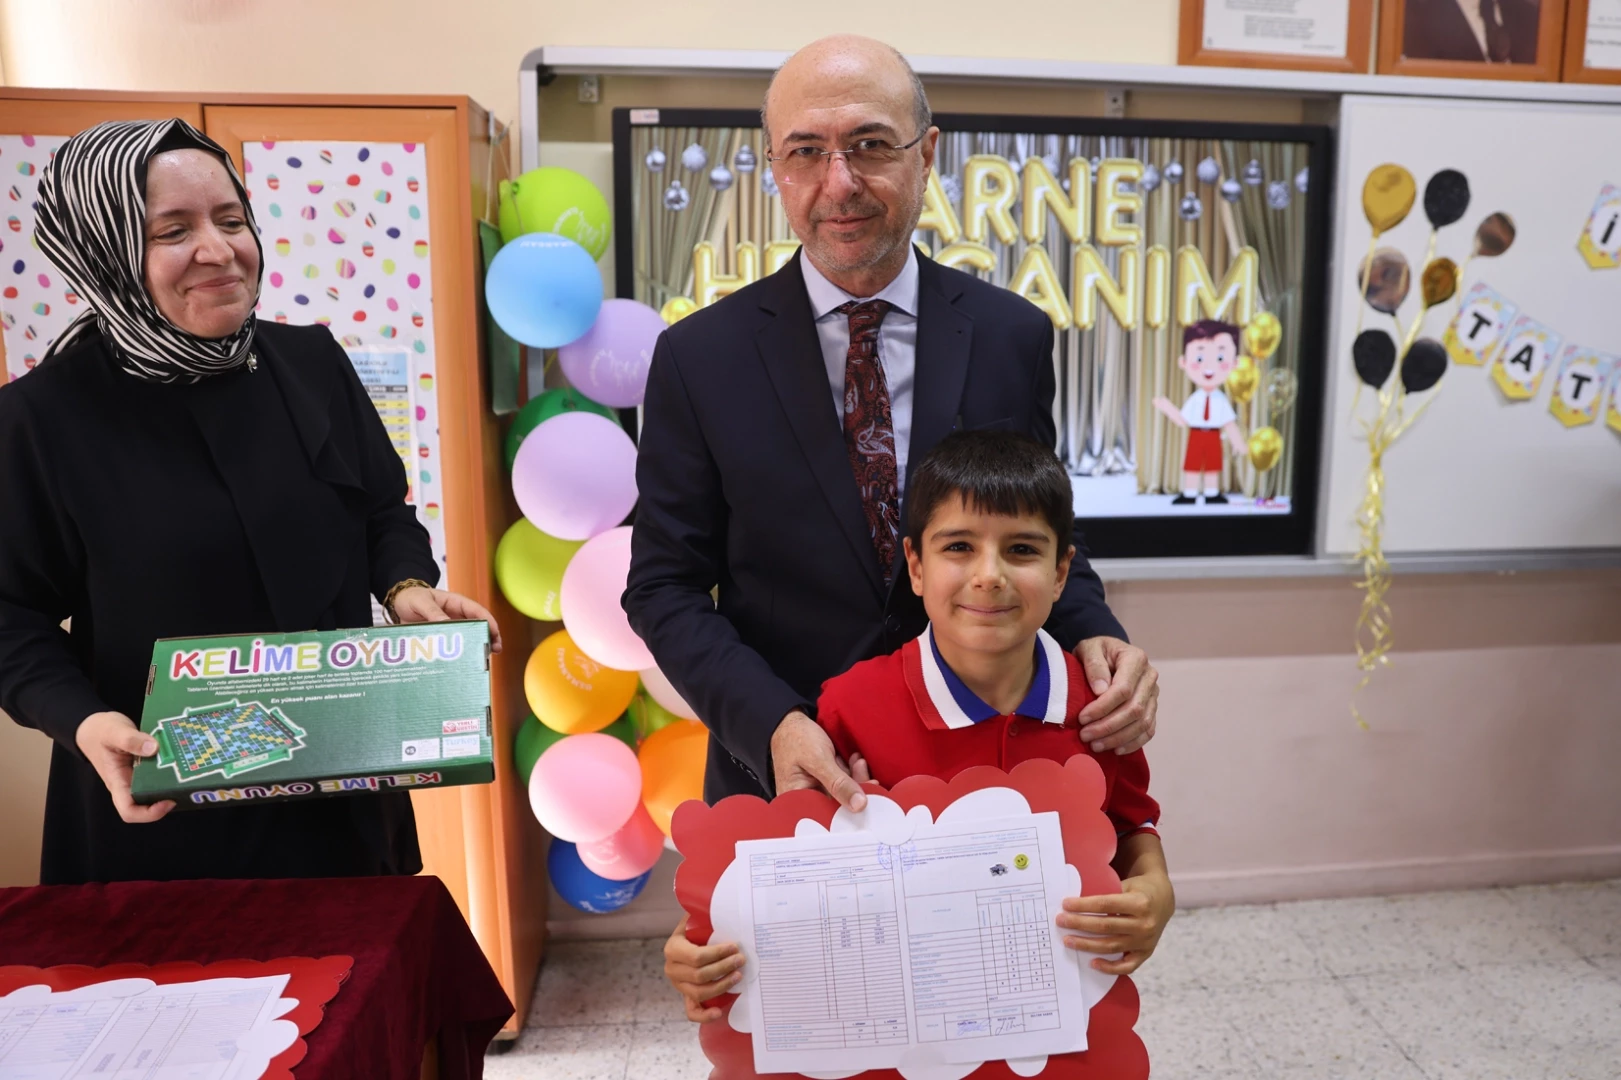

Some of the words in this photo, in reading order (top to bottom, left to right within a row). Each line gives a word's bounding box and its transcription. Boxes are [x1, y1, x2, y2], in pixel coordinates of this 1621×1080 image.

[915, 153, 1143, 246] ARNE
[171, 639, 320, 679] KELİME
[329, 634, 462, 668] OYUNU
[280, 696, 304, 704] yüksek
[304, 694, 323, 702] puanı
[191, 782, 312, 804] OYUNU
[320, 772, 441, 792] KELİME
